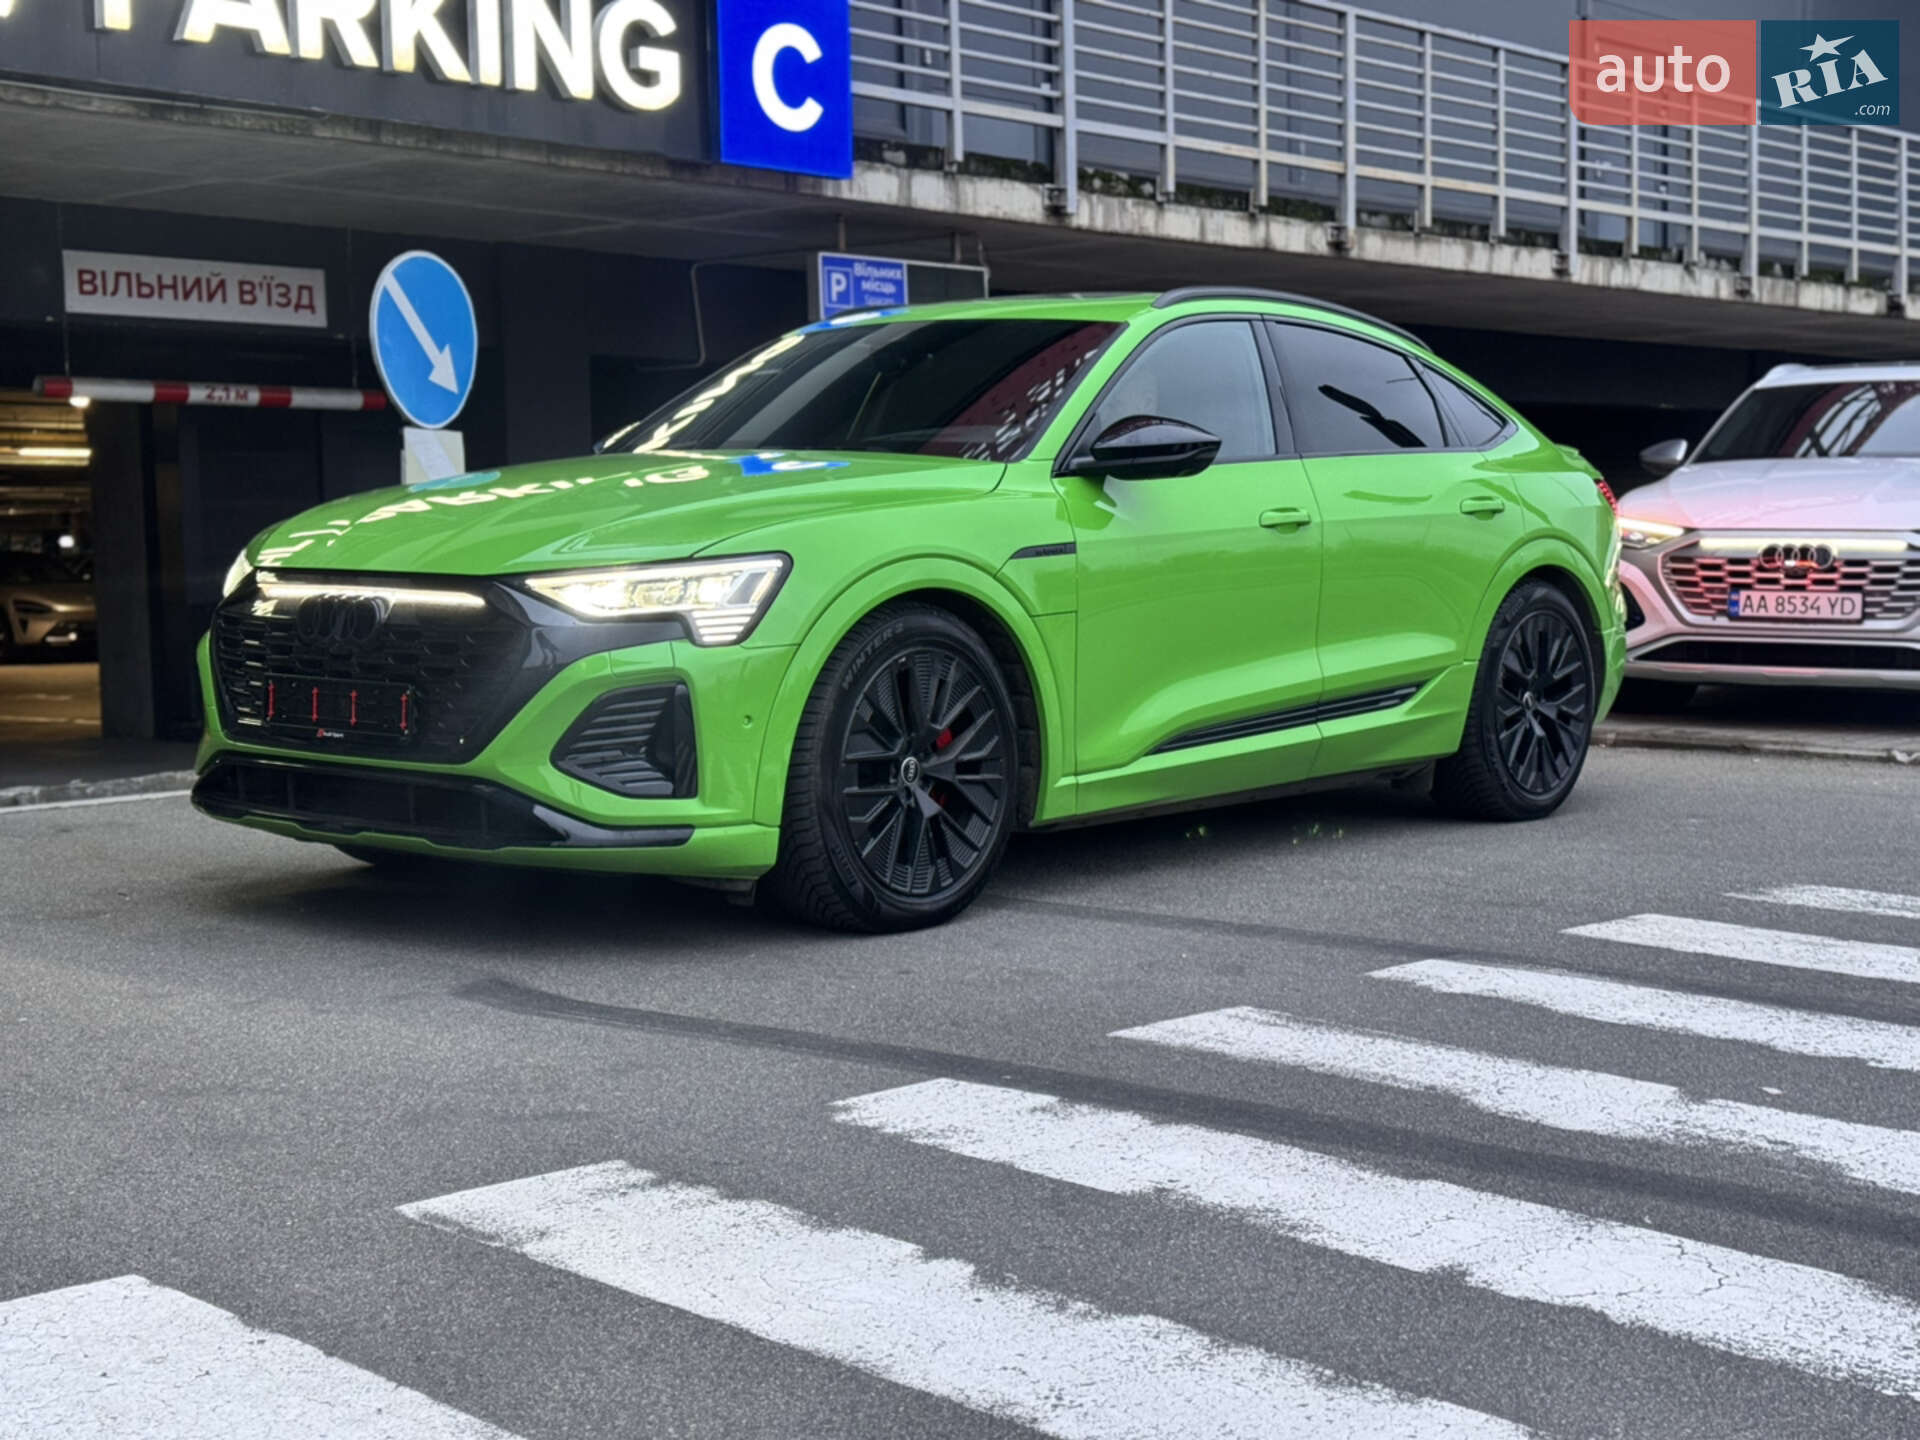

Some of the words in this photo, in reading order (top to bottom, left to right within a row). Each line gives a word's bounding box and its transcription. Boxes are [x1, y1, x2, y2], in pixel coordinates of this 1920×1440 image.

[97, 0, 681, 111] ARKING
[752, 22, 824, 132] C
[77, 268, 228, 304] ВІЛЬНИЙ
[238, 275, 317, 314] В'ЇЗД
[831, 272, 847, 302] P
[1742, 595, 1769, 613] AA
[1775, 595, 1821, 615] 8534
[1827, 597, 1856, 615] YD
